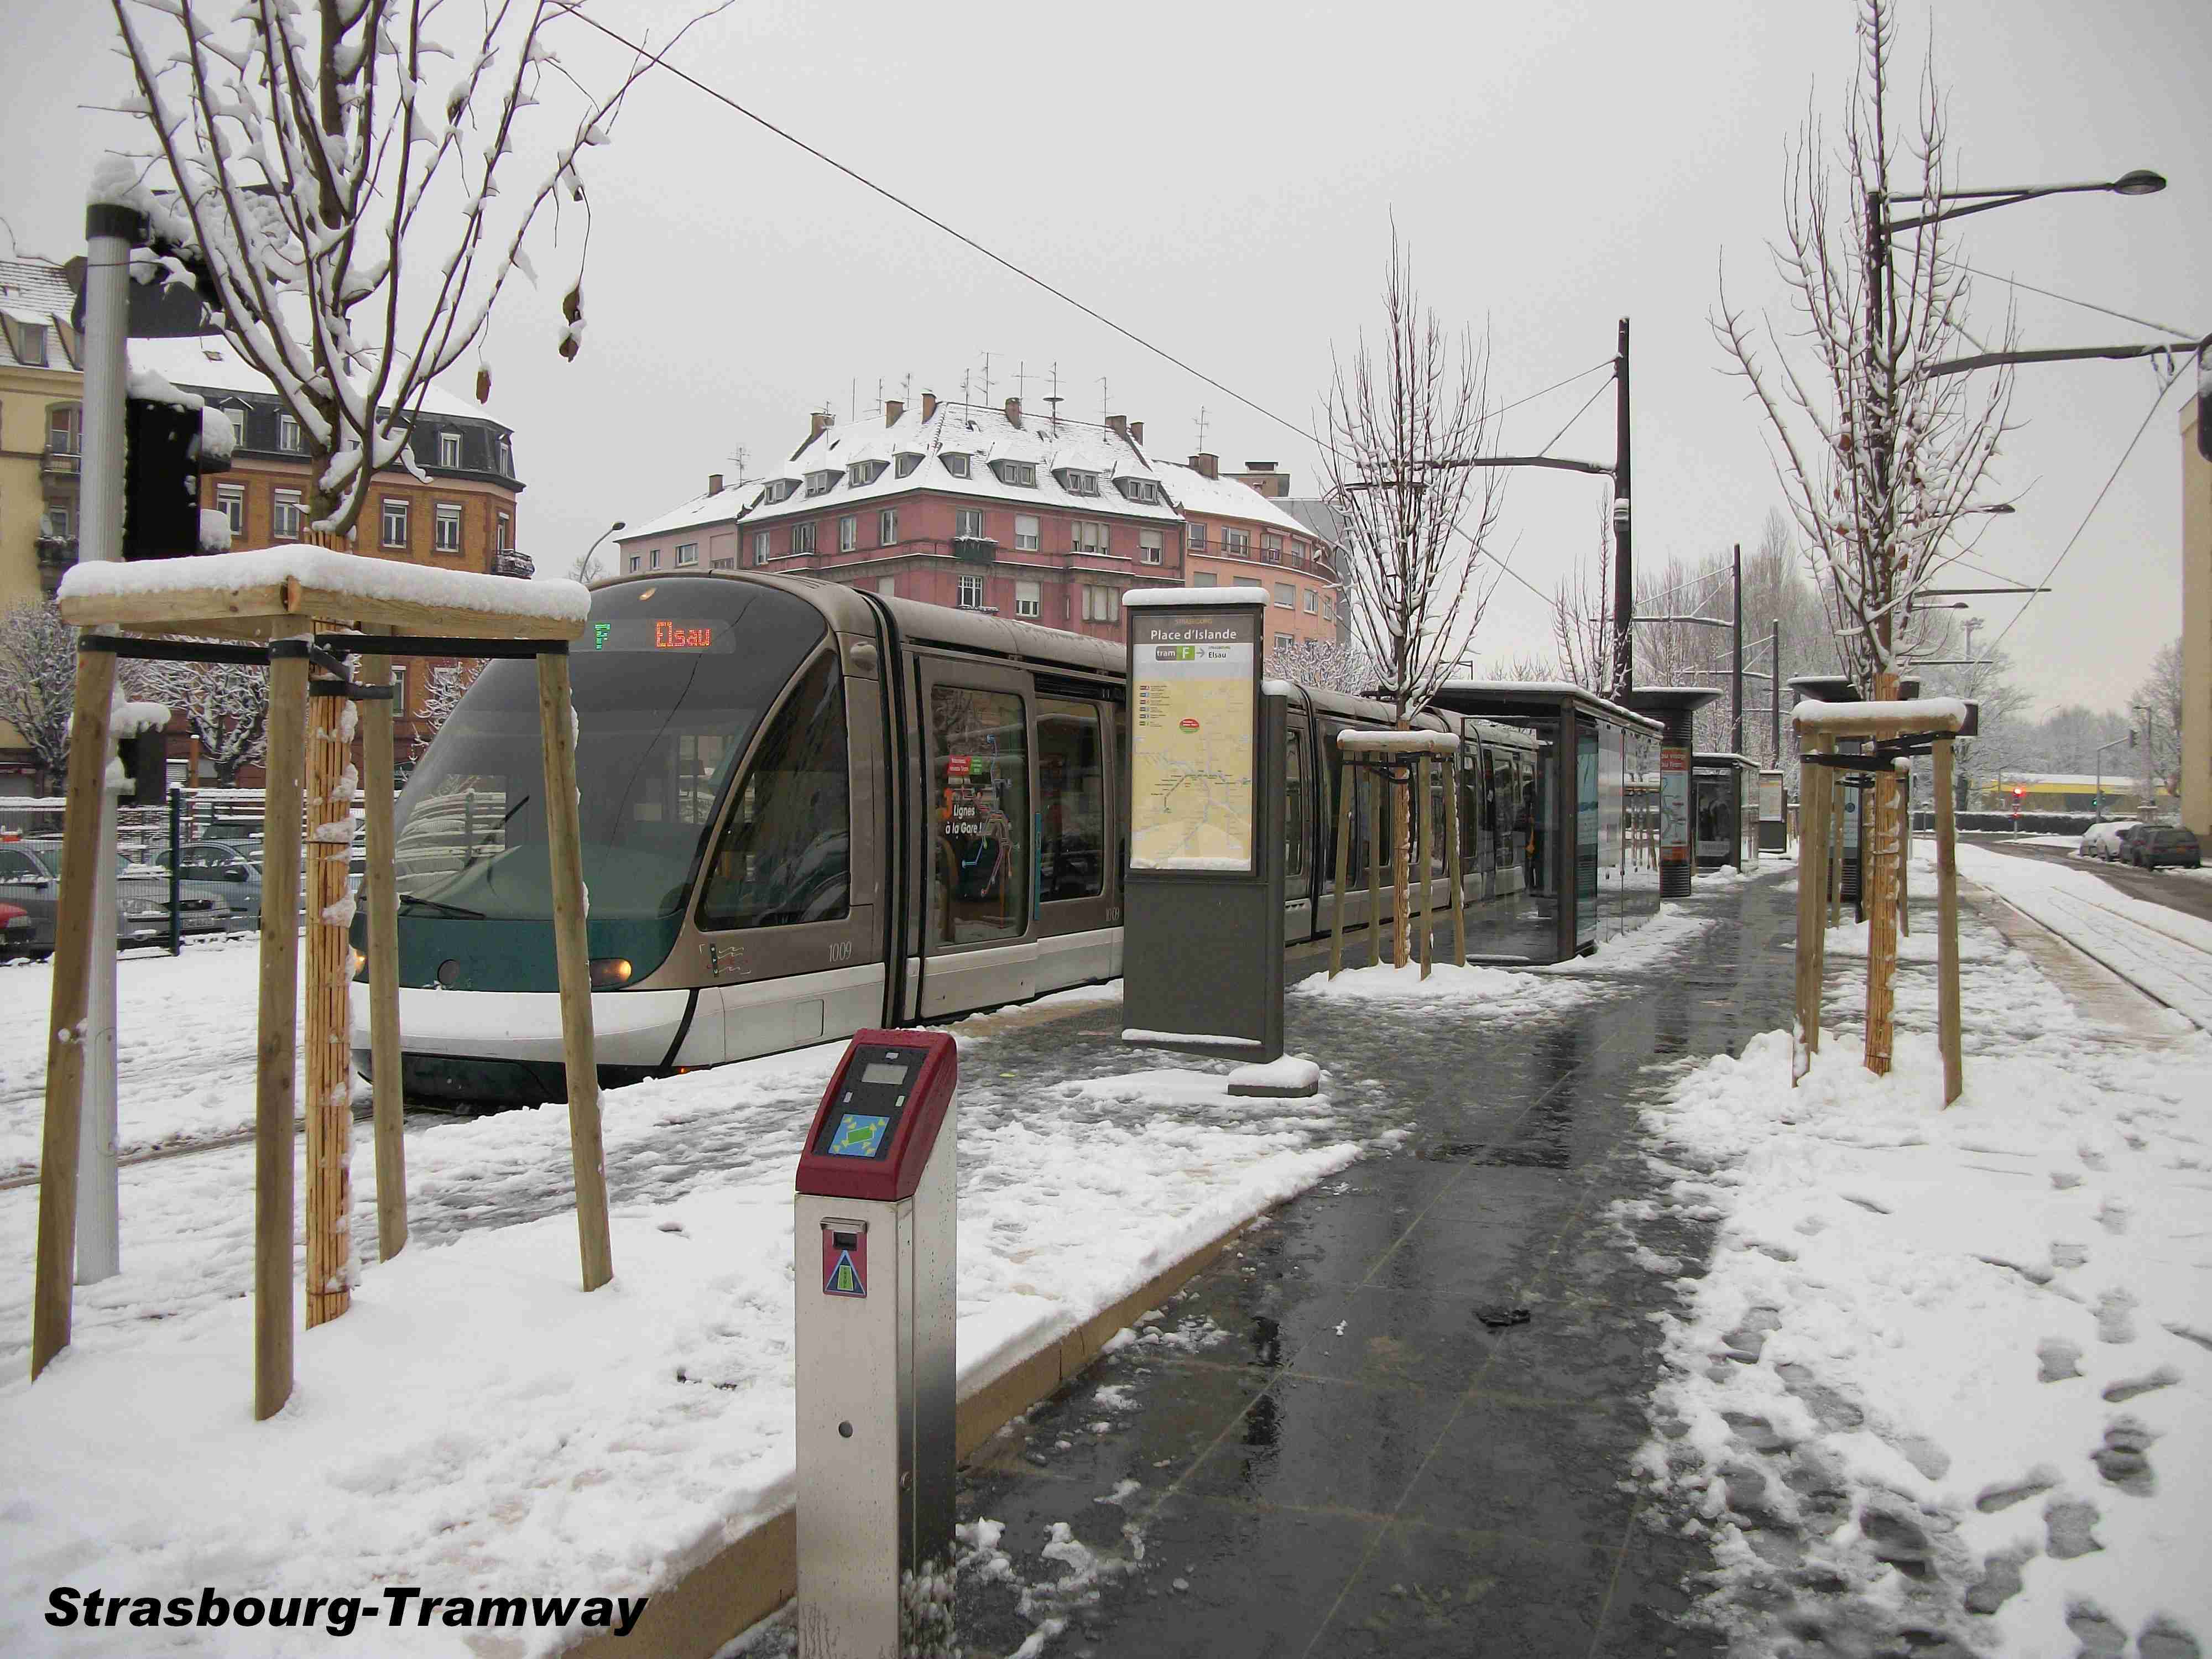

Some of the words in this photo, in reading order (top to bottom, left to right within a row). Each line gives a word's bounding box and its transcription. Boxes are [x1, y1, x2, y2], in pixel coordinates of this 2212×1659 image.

[594, 623, 611, 650] F
[656, 620, 711, 647] Elsau
[1151, 630, 1181, 640] Place
[1183, 628, 1237, 640] d'Islande
[1182, 646, 1190, 659] F
[953, 805, 975, 820] Lignes
[946, 821, 951, 834] à
[952, 822, 959, 834] la
[961, 822, 978, 833] Gare
[829, 941, 852, 963] 1009
